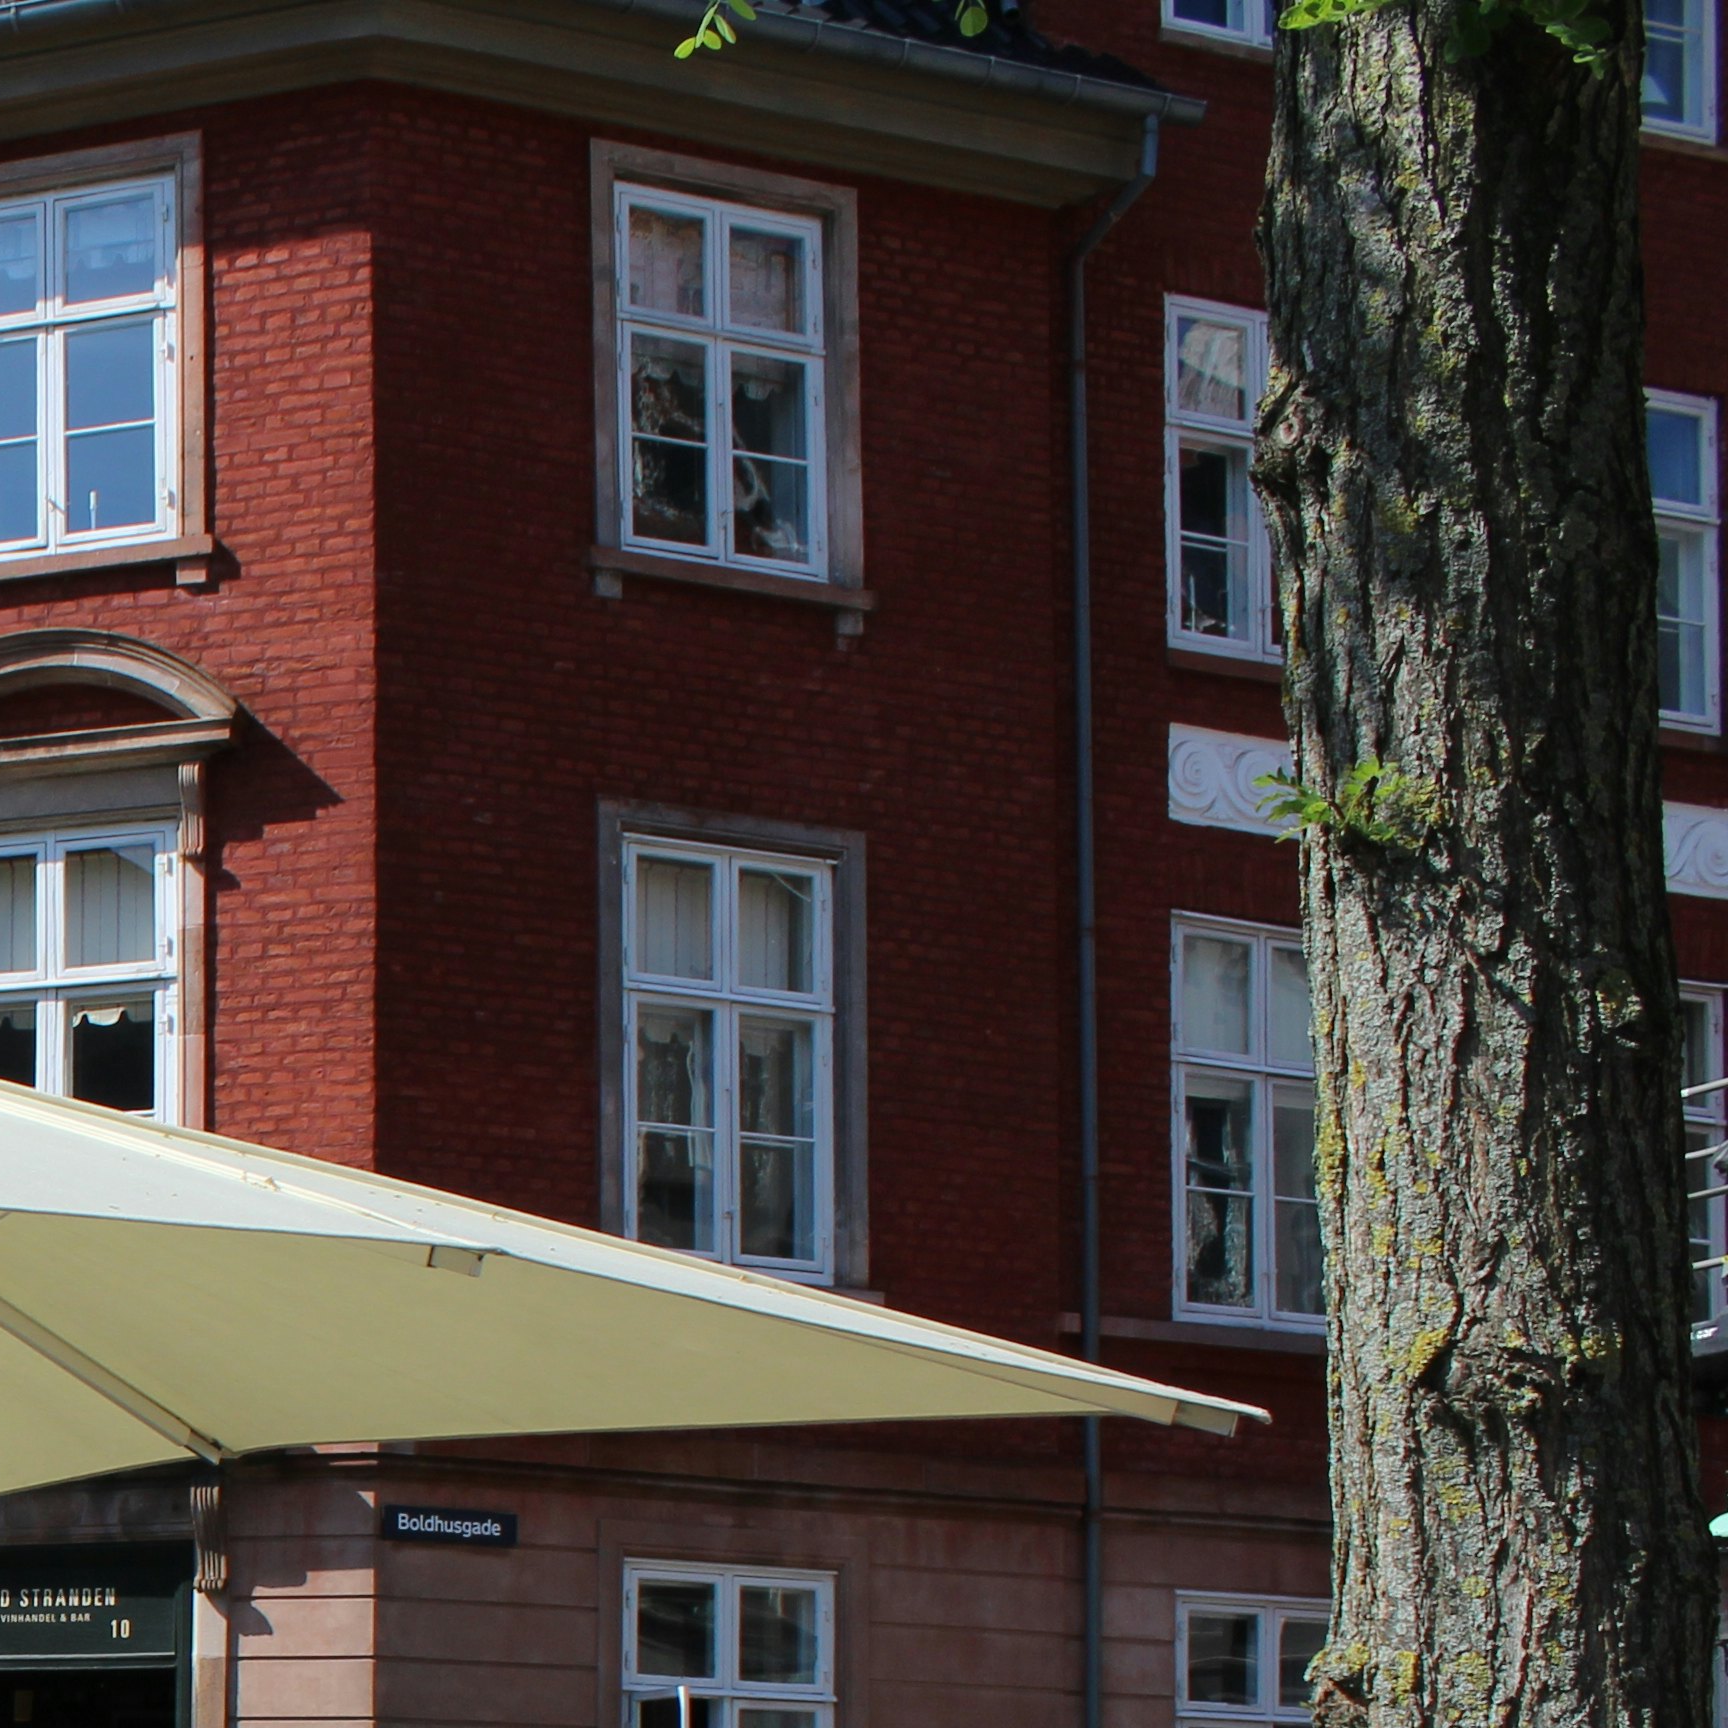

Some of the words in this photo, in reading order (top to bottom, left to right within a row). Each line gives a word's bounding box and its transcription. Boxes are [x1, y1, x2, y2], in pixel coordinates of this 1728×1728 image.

[397, 1512, 502, 1538] Boldhusgade
[19, 1587, 116, 1607] STRANDEN
[0, 1613, 56, 1623] VINHANDEL
[60, 1613, 67, 1622] &
[70, 1612, 91, 1622] BAR
[110, 1619, 130, 1639] 10
